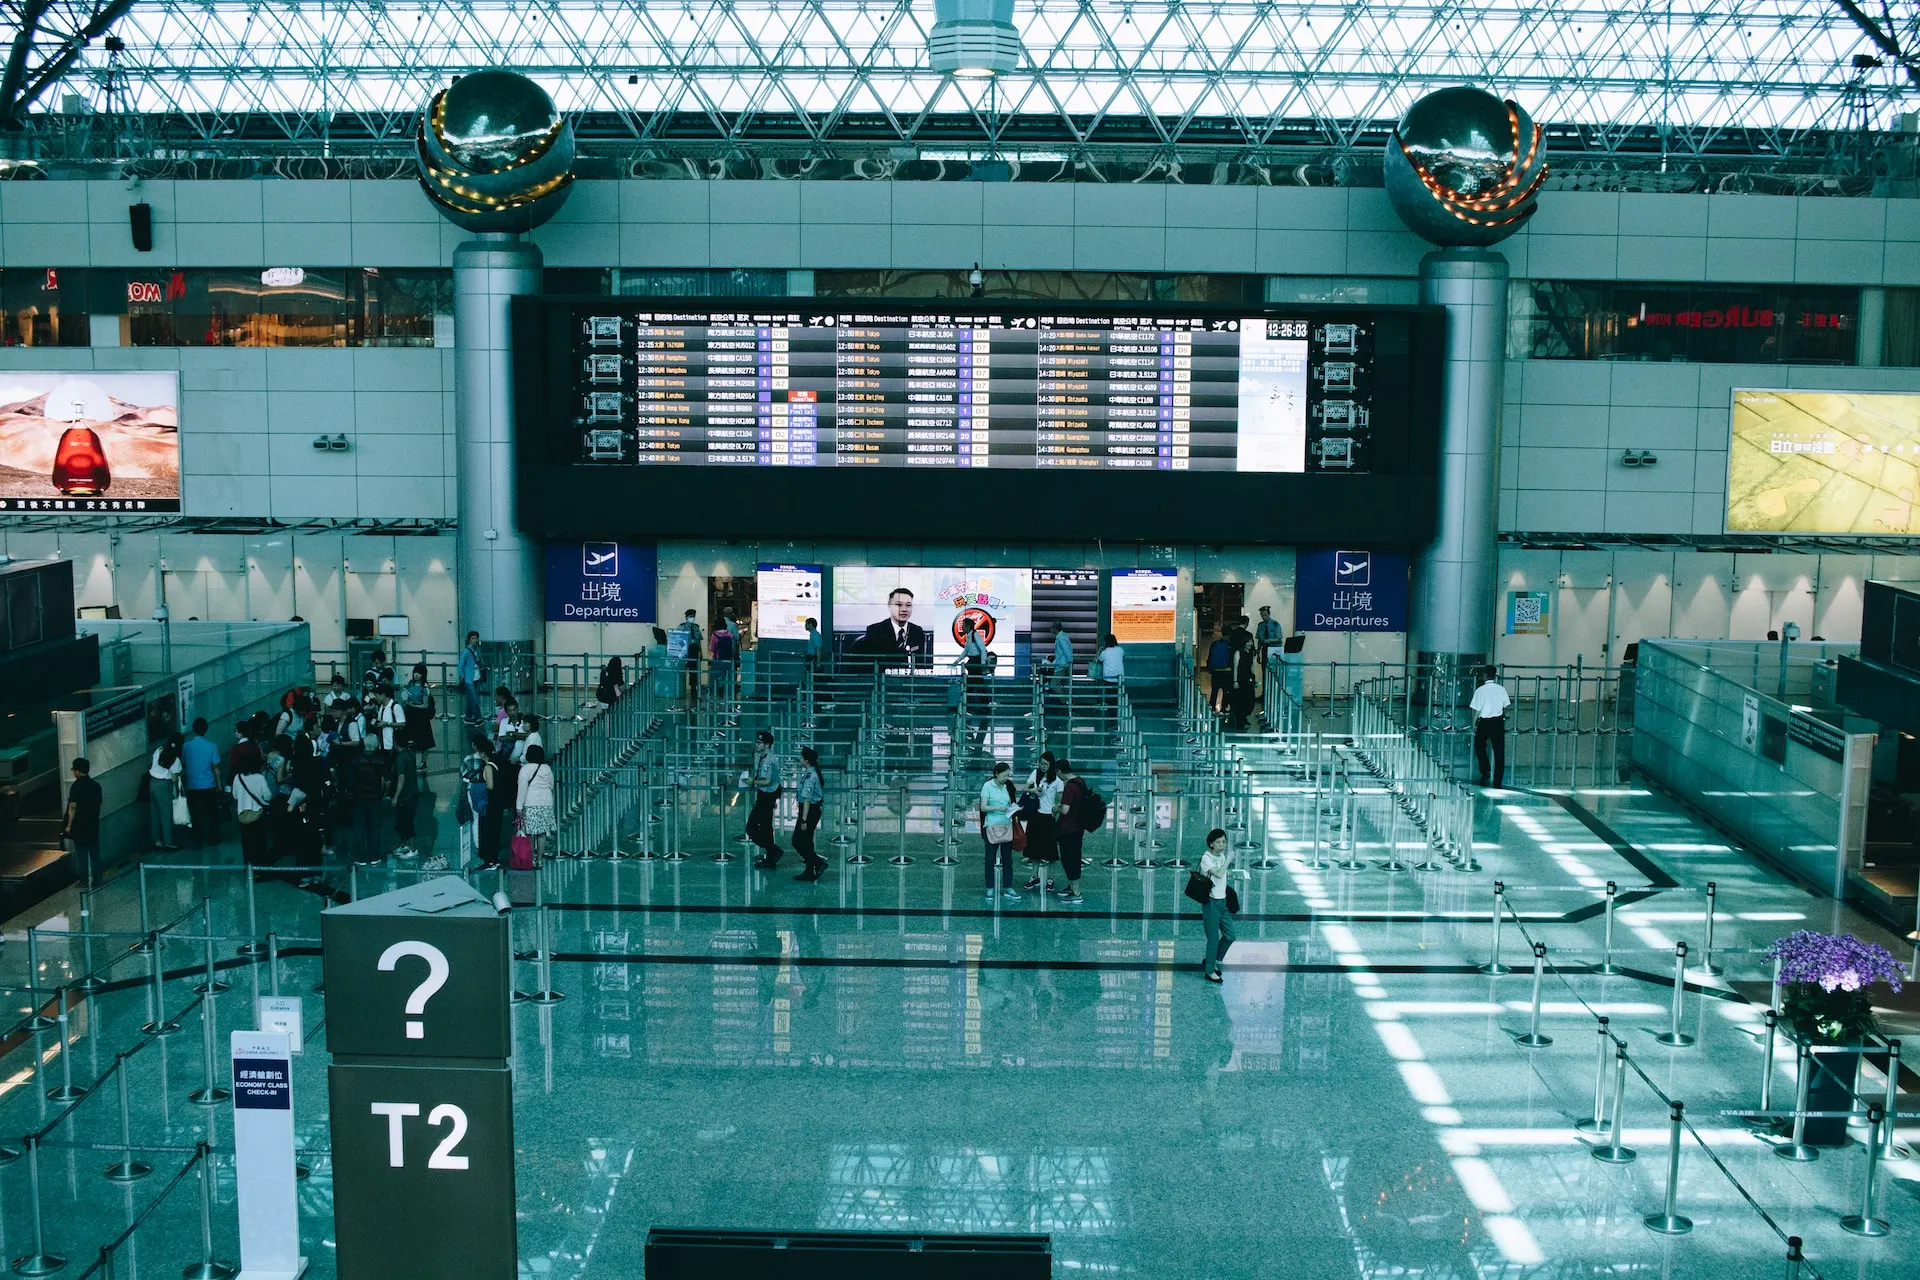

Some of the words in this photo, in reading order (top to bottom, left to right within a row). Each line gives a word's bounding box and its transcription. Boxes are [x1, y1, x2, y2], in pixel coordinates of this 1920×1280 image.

[1268, 323, 1307, 337] 12:26:03
[582, 582, 621, 601] 出境
[1333, 591, 1372, 611] 出境
[565, 604, 638, 619] Departures
[1315, 614, 1389, 628] Departures
[370, 1102, 469, 1170] T2
